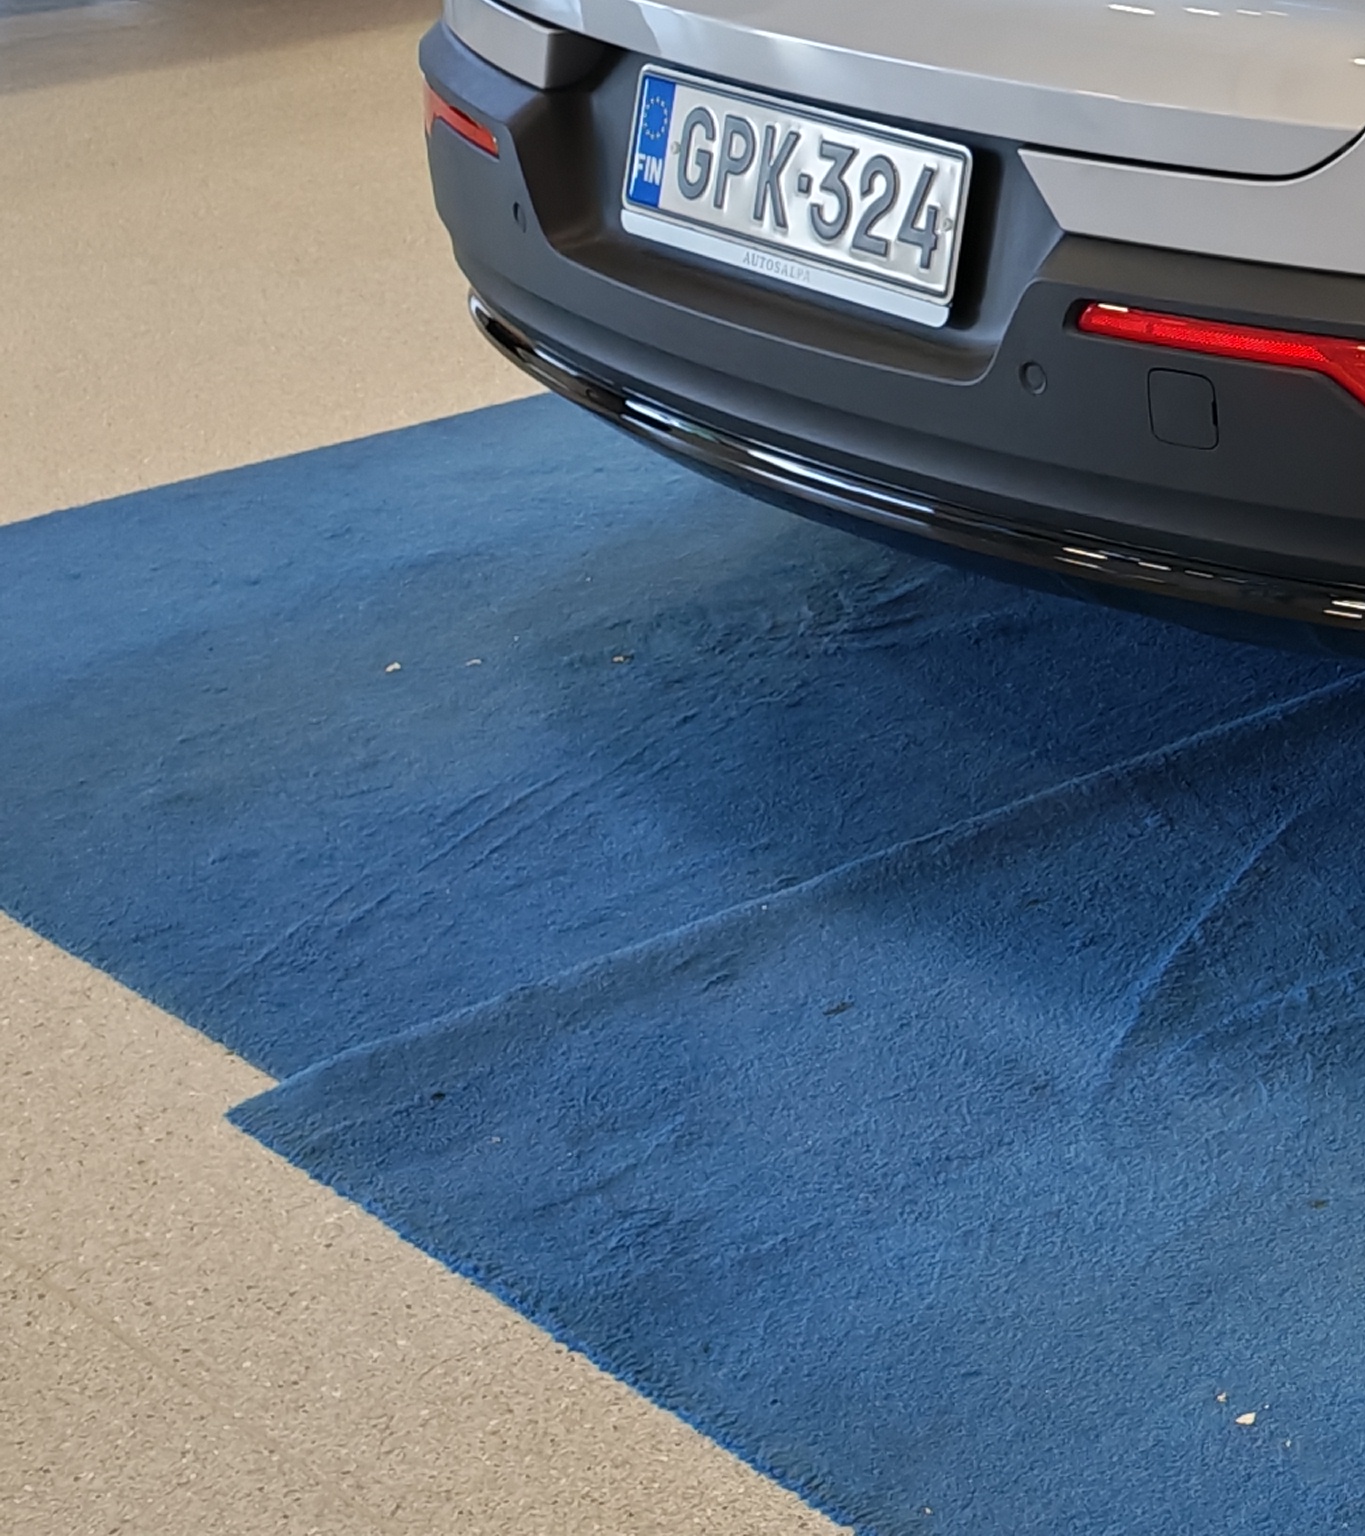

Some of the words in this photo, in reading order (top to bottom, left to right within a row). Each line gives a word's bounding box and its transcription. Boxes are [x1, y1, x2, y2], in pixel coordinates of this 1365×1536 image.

[635, 153, 664, 186] FIN
[676, 105, 943, 272] GPK-324
[742, 250, 812, 285] AUTOSALPA
